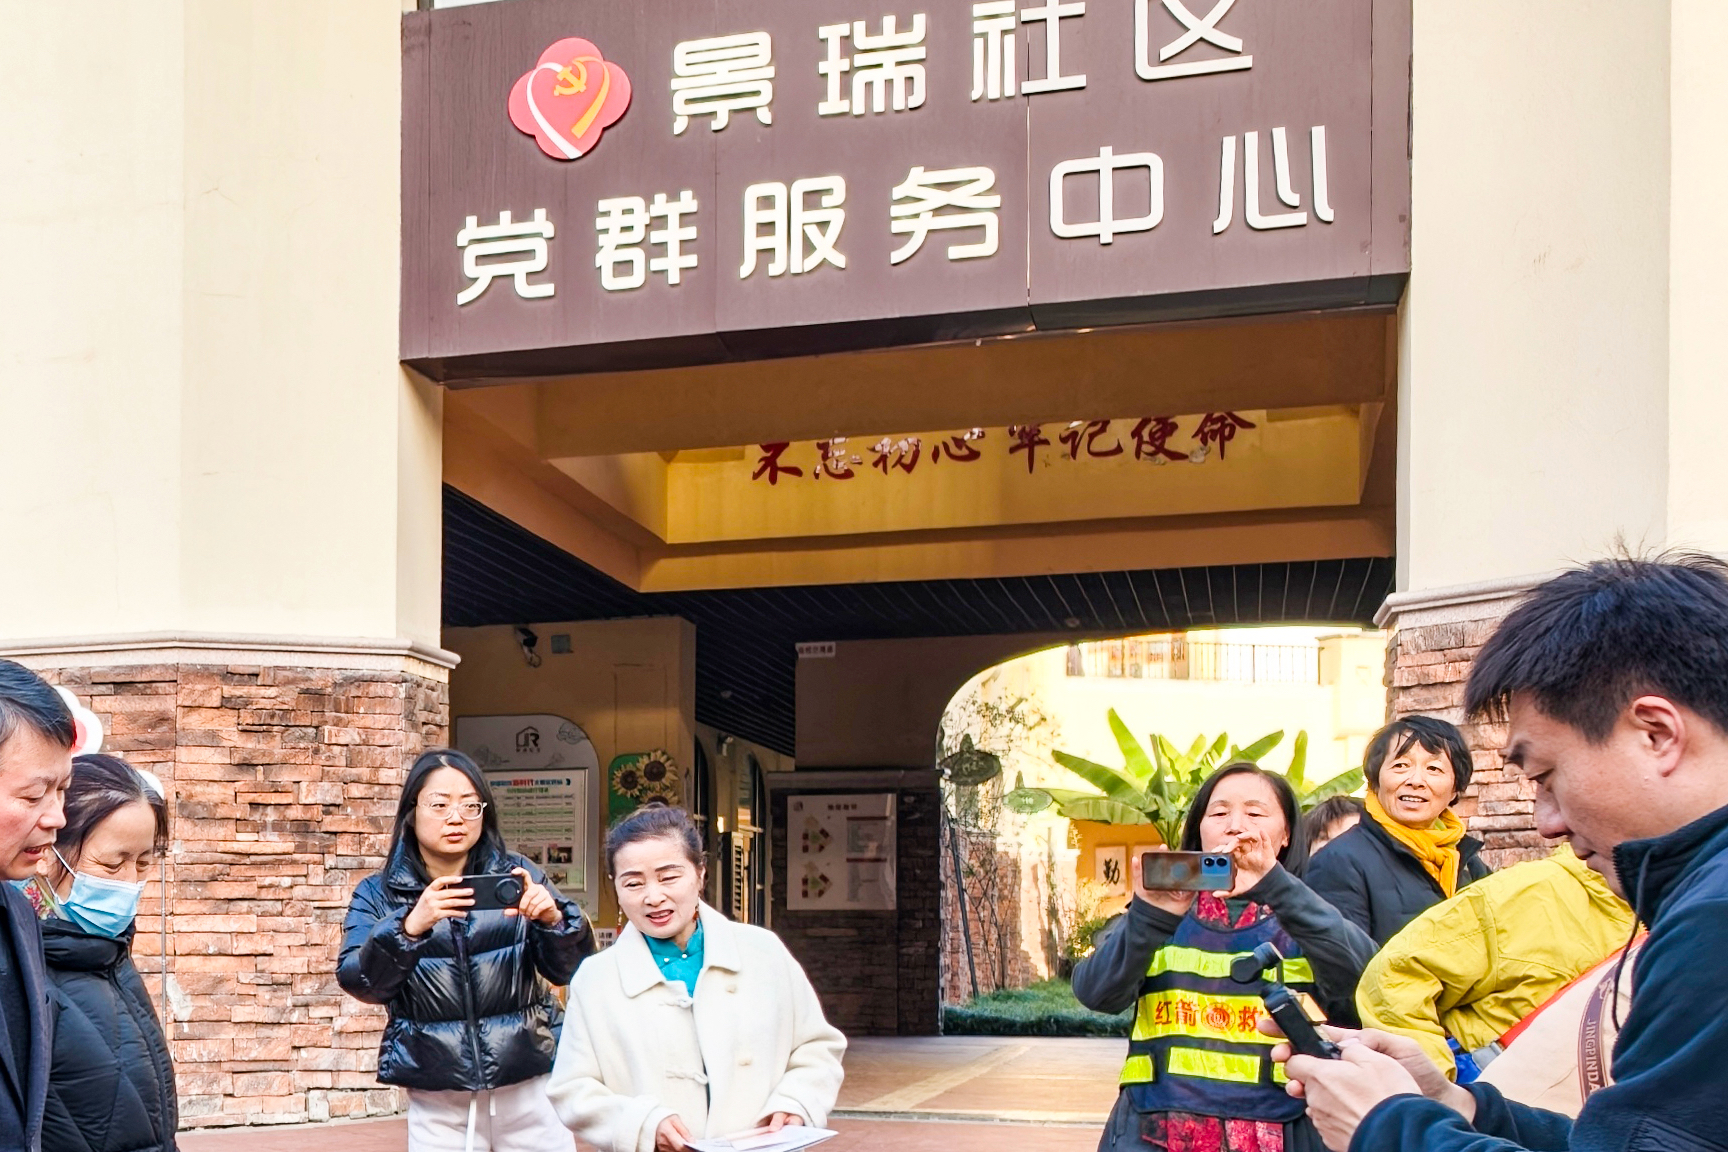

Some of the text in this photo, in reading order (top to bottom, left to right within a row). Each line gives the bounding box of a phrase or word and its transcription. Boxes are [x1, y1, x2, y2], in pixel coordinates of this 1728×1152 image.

[670, 0, 1254, 136] 景瑞社区
[455, 124, 1335, 307] 党群服务中心
